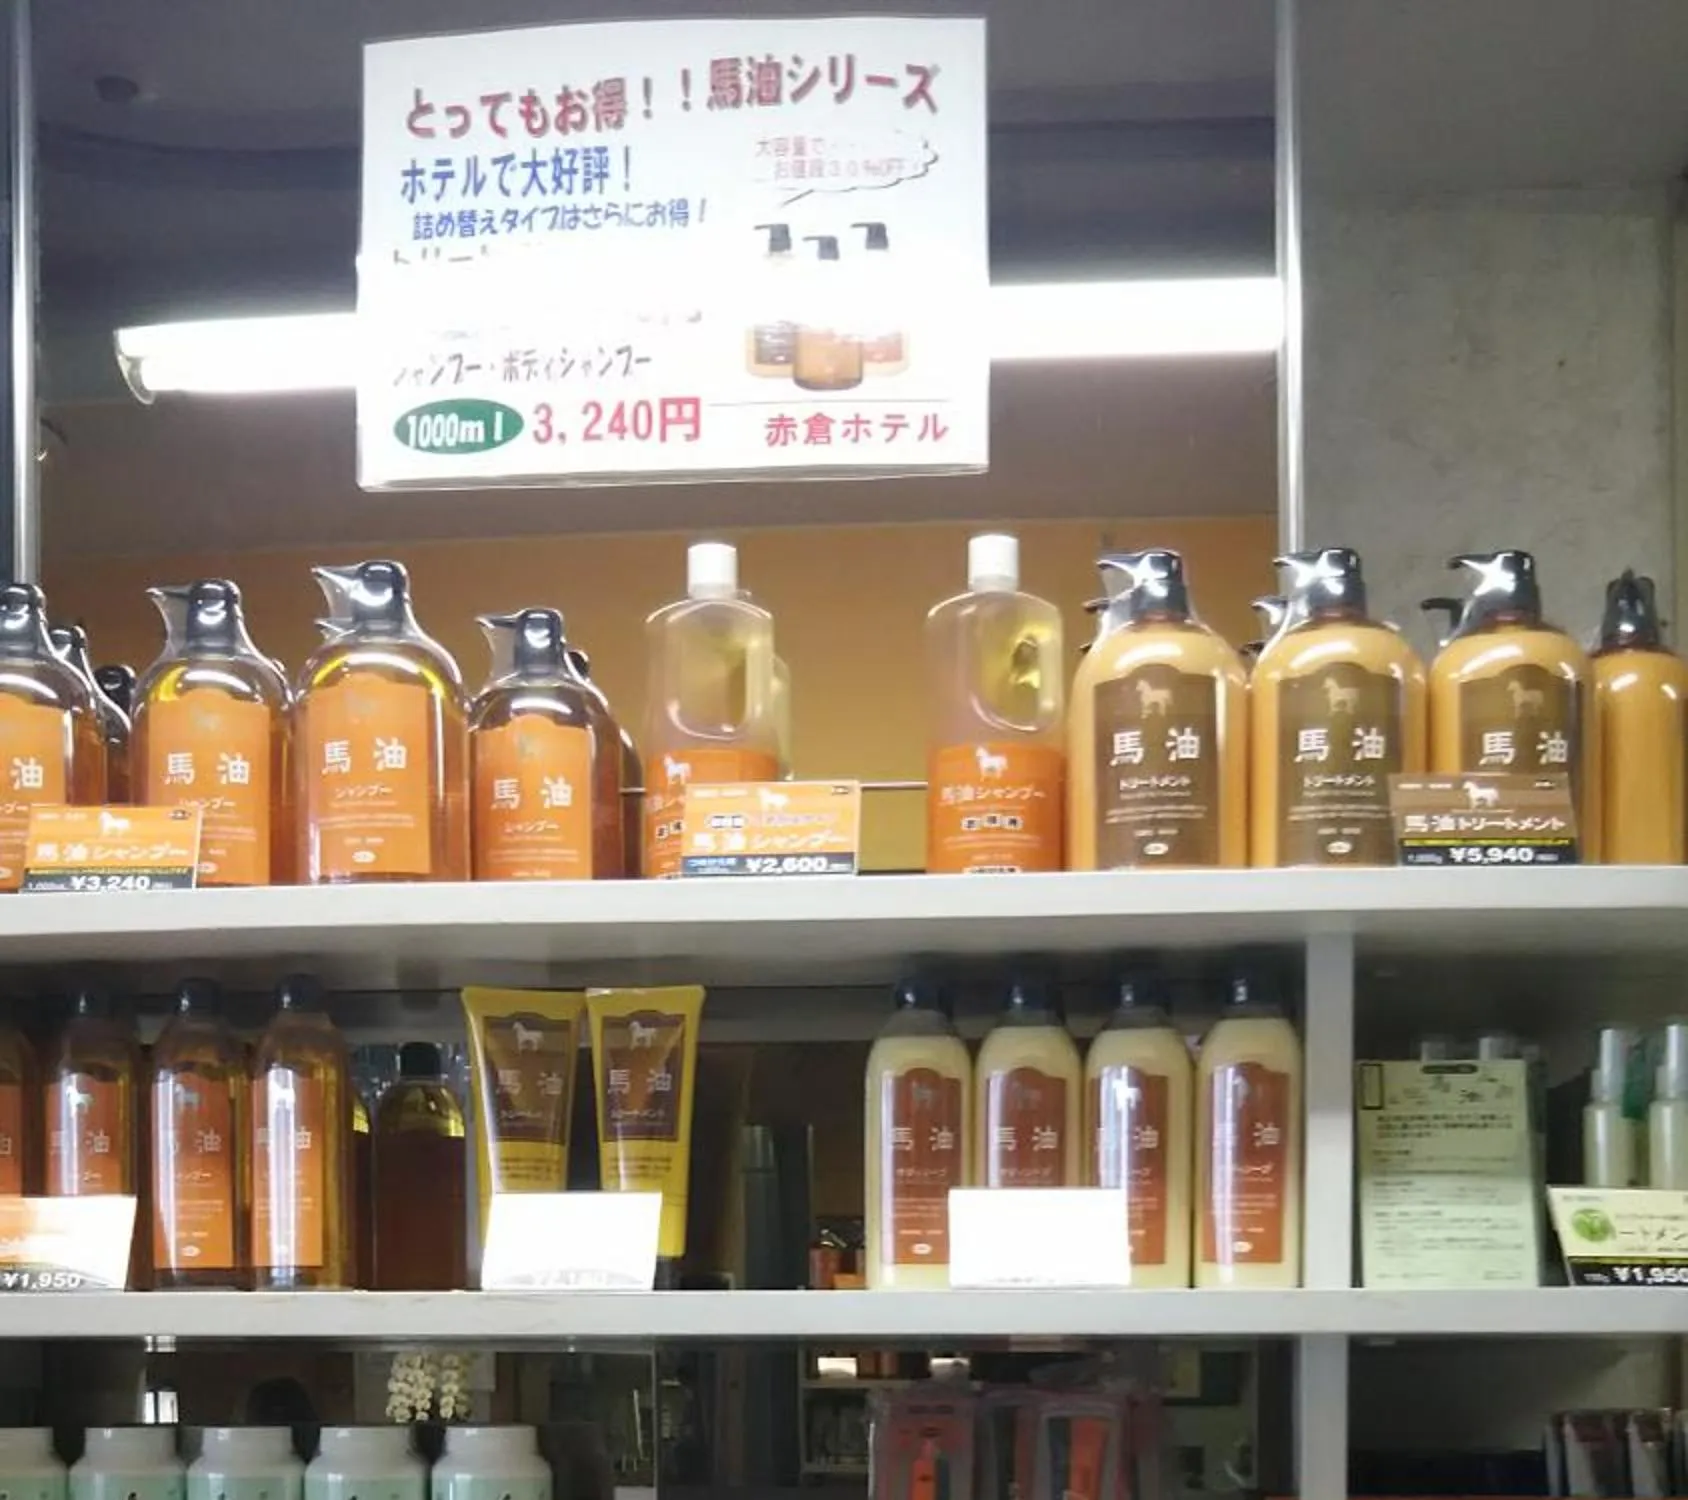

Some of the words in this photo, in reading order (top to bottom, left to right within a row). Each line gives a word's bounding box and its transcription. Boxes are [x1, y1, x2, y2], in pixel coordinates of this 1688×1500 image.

[400, 146, 632, 204] ホテルで大好評！
[532, 397, 702, 445] 3,240円
[765, 413, 949, 447] 赤倉ホテル
[322, 737, 407, 776] 馬油
[1110, 726, 1201, 767] 馬油
[1294, 726, 1385, 763] 馬油
[1478, 730, 1569, 766] 馬油
[165, 752, 250, 787] 馬油
[334, 784, 393, 799] シャンプー
[490, 774, 573, 810] 馬油
[1403, 813, 1566, 833] 馬油トリートメント
[35, 841, 190, 862] 馬油シャンプー
[745, 856, 828, 873] ¥2,600
[1449, 846, 1535, 864] ¥5,940
[71, 875, 151, 891] ¥3,240
[496, 1069, 563, 1096] 馬油
[608, 1068, 672, 1095] 馬油
[4, 1271, 82, 1289] ¥1,950
